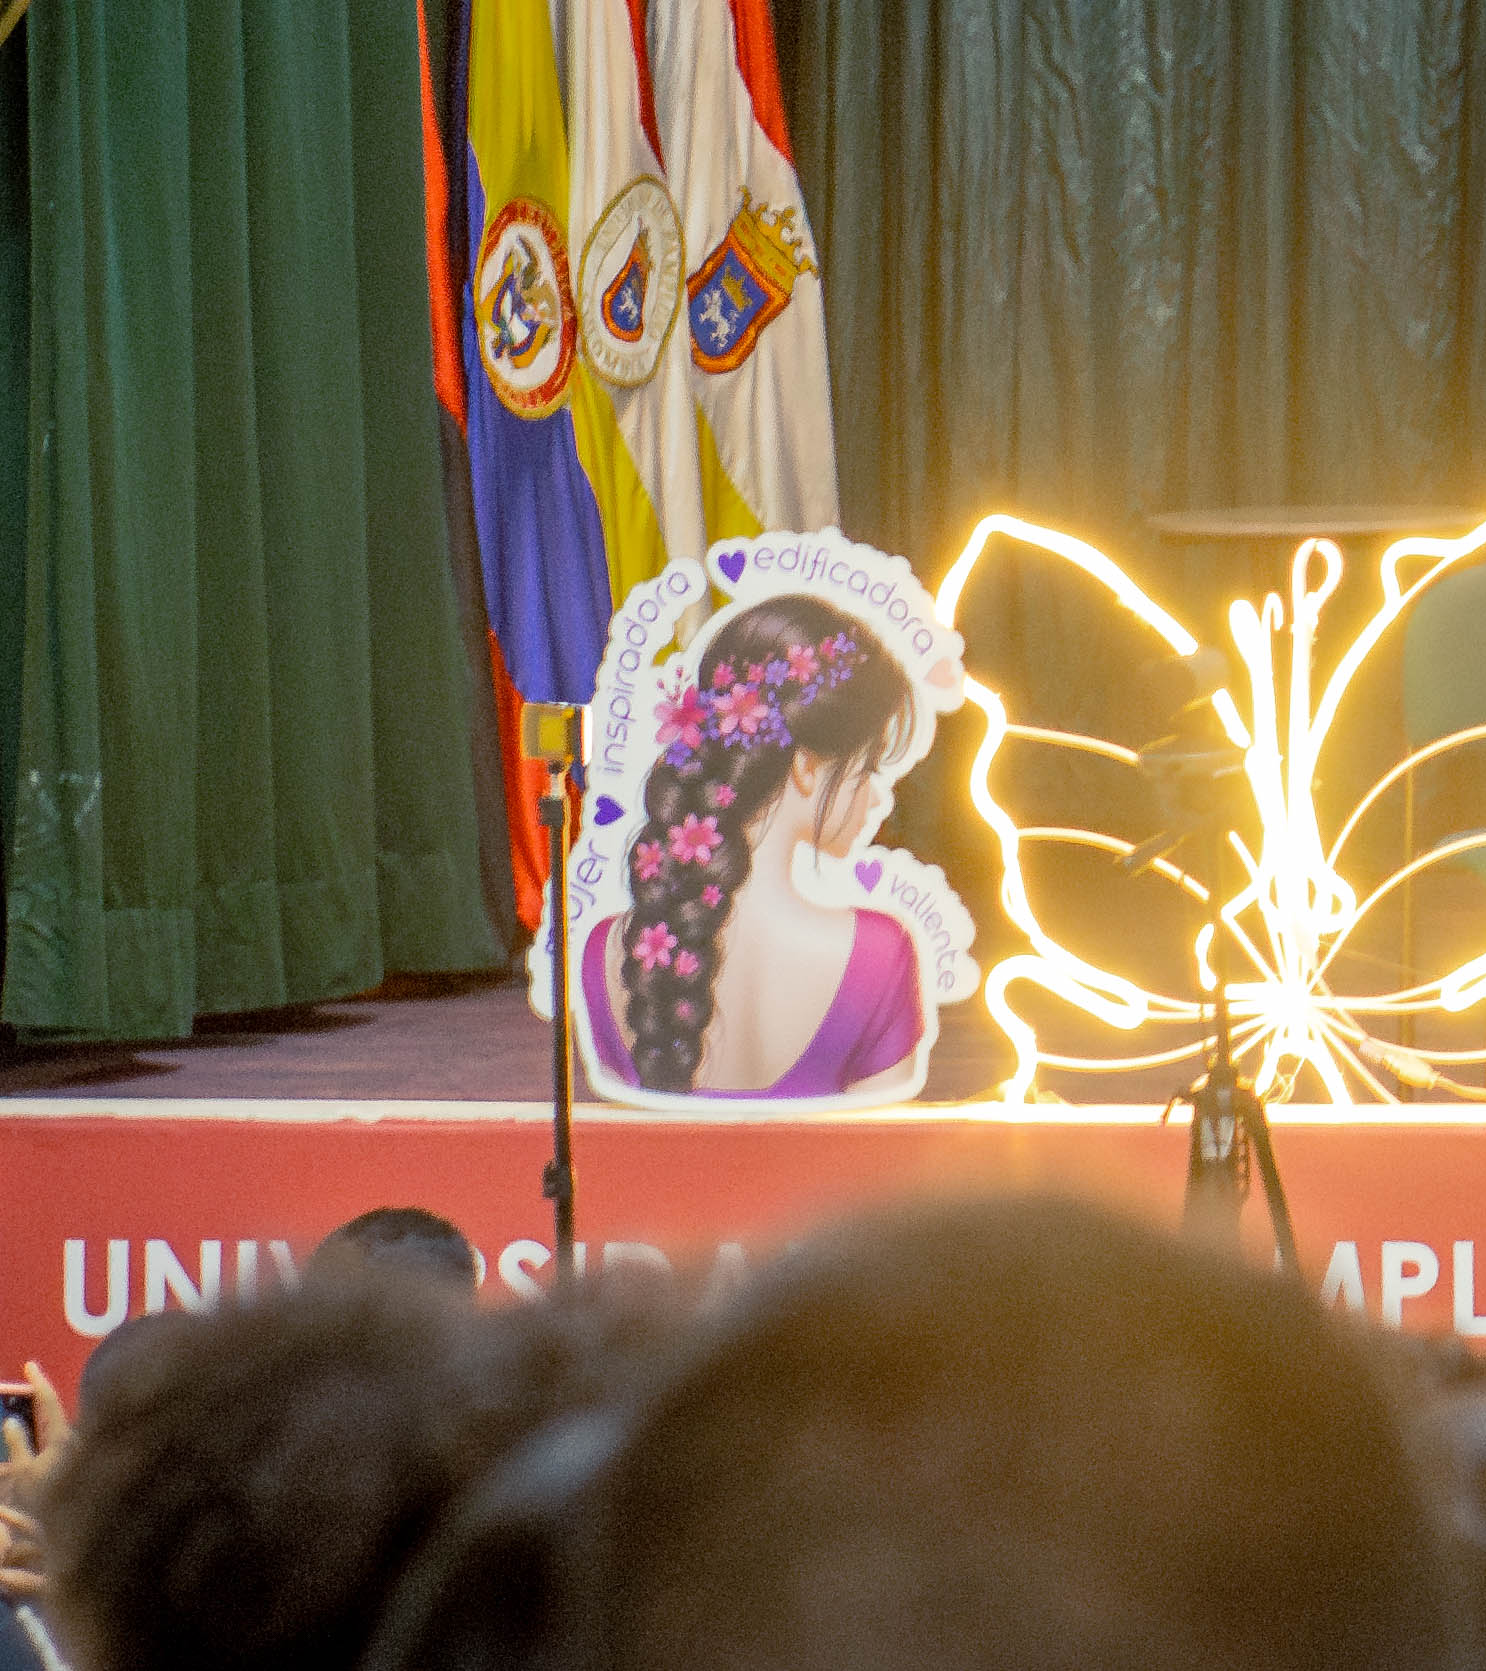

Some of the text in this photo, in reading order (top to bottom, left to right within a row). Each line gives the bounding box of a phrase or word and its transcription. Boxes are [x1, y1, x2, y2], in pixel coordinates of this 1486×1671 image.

[597, 571, 691, 774] inspiradora
[754, 542, 933, 656] edificadora
[890, 874, 960, 992] valiente
